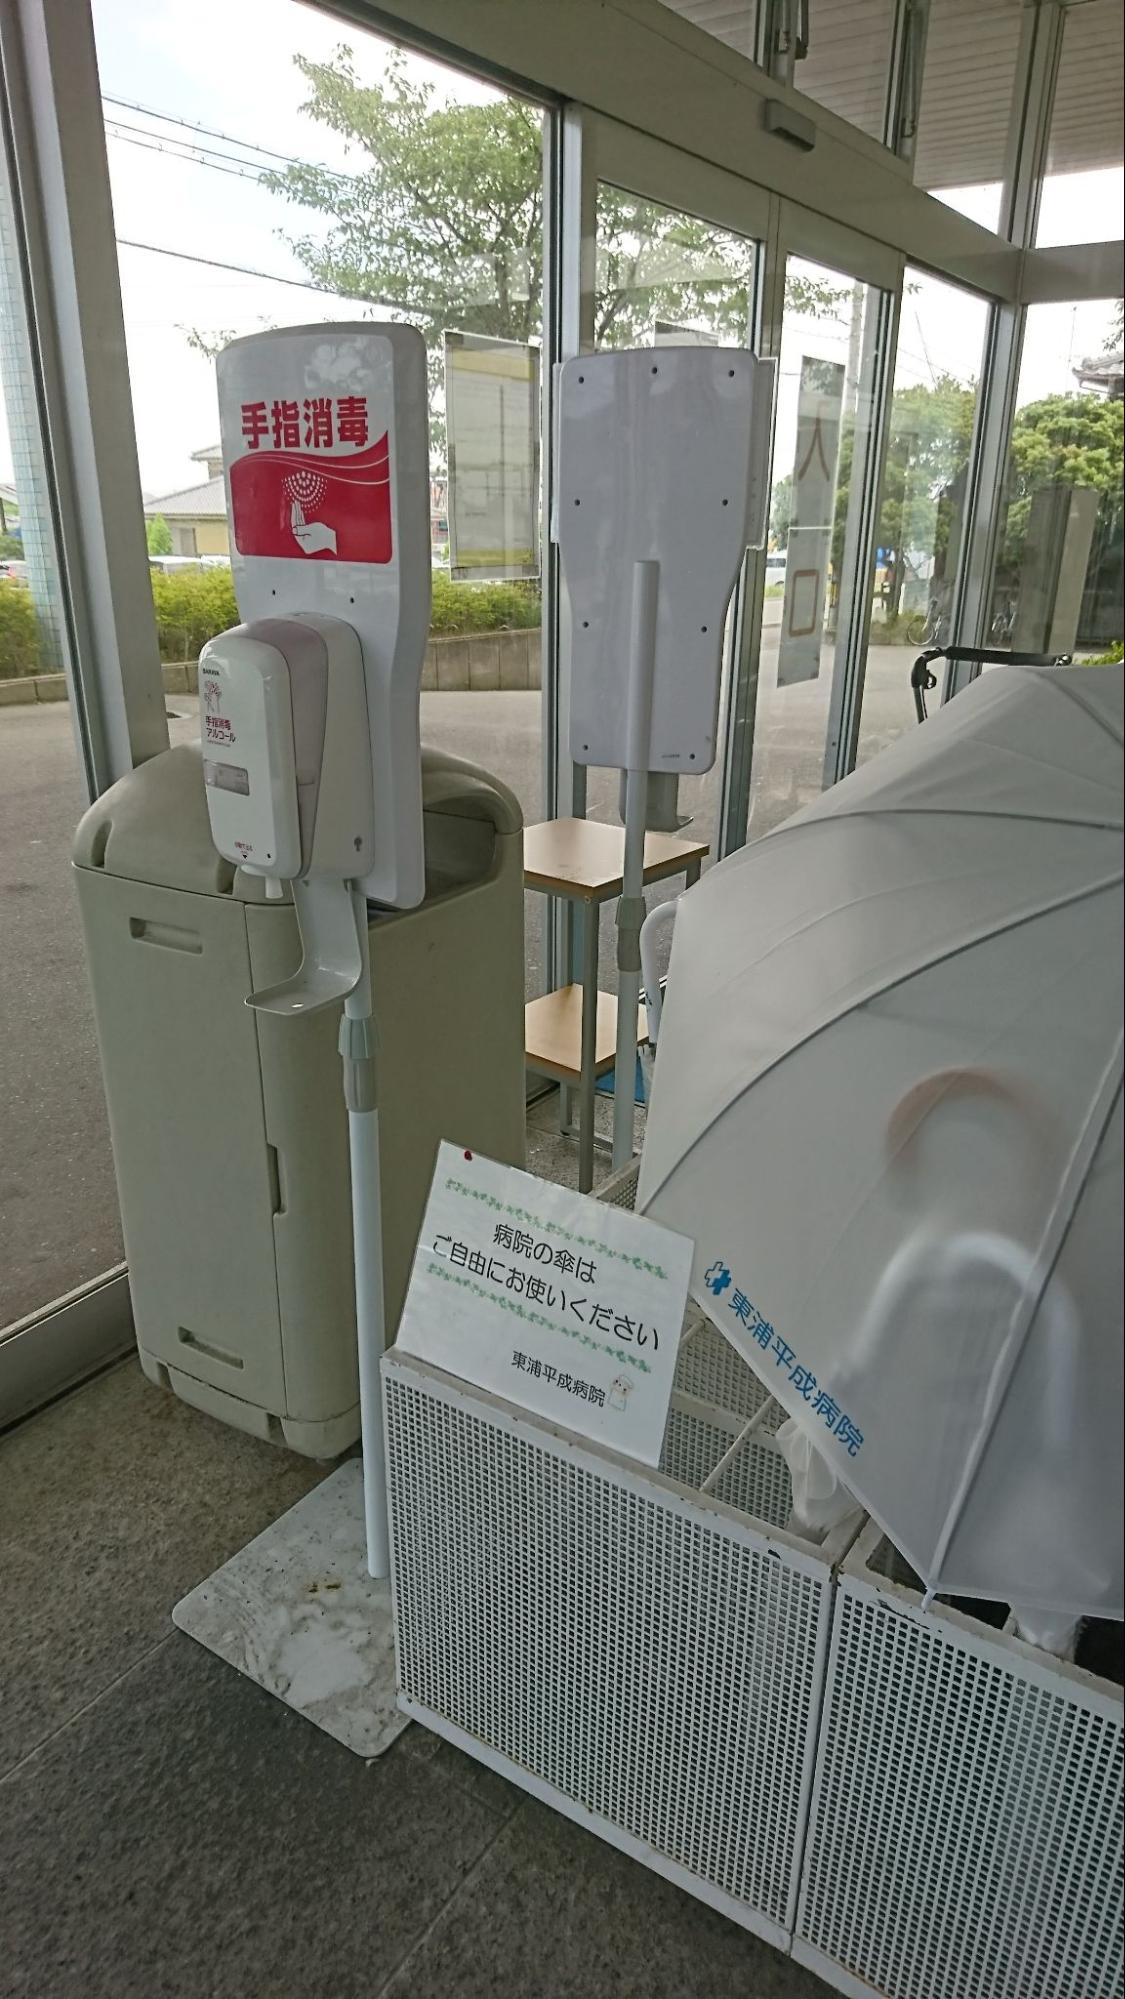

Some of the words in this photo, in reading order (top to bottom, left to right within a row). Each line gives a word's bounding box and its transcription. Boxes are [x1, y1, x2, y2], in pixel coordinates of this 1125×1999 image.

[241, 396, 369, 450] 手指消毒
[206, 727, 236, 743] アルコール
[492, 1223, 596, 1285] 病院の傘は
[432, 1233, 660, 1350] ご自由にお使いください
[510, 1350, 607, 1408] 東浦平成病院
[727, 1287, 864, 1457] 東浦平成病院
